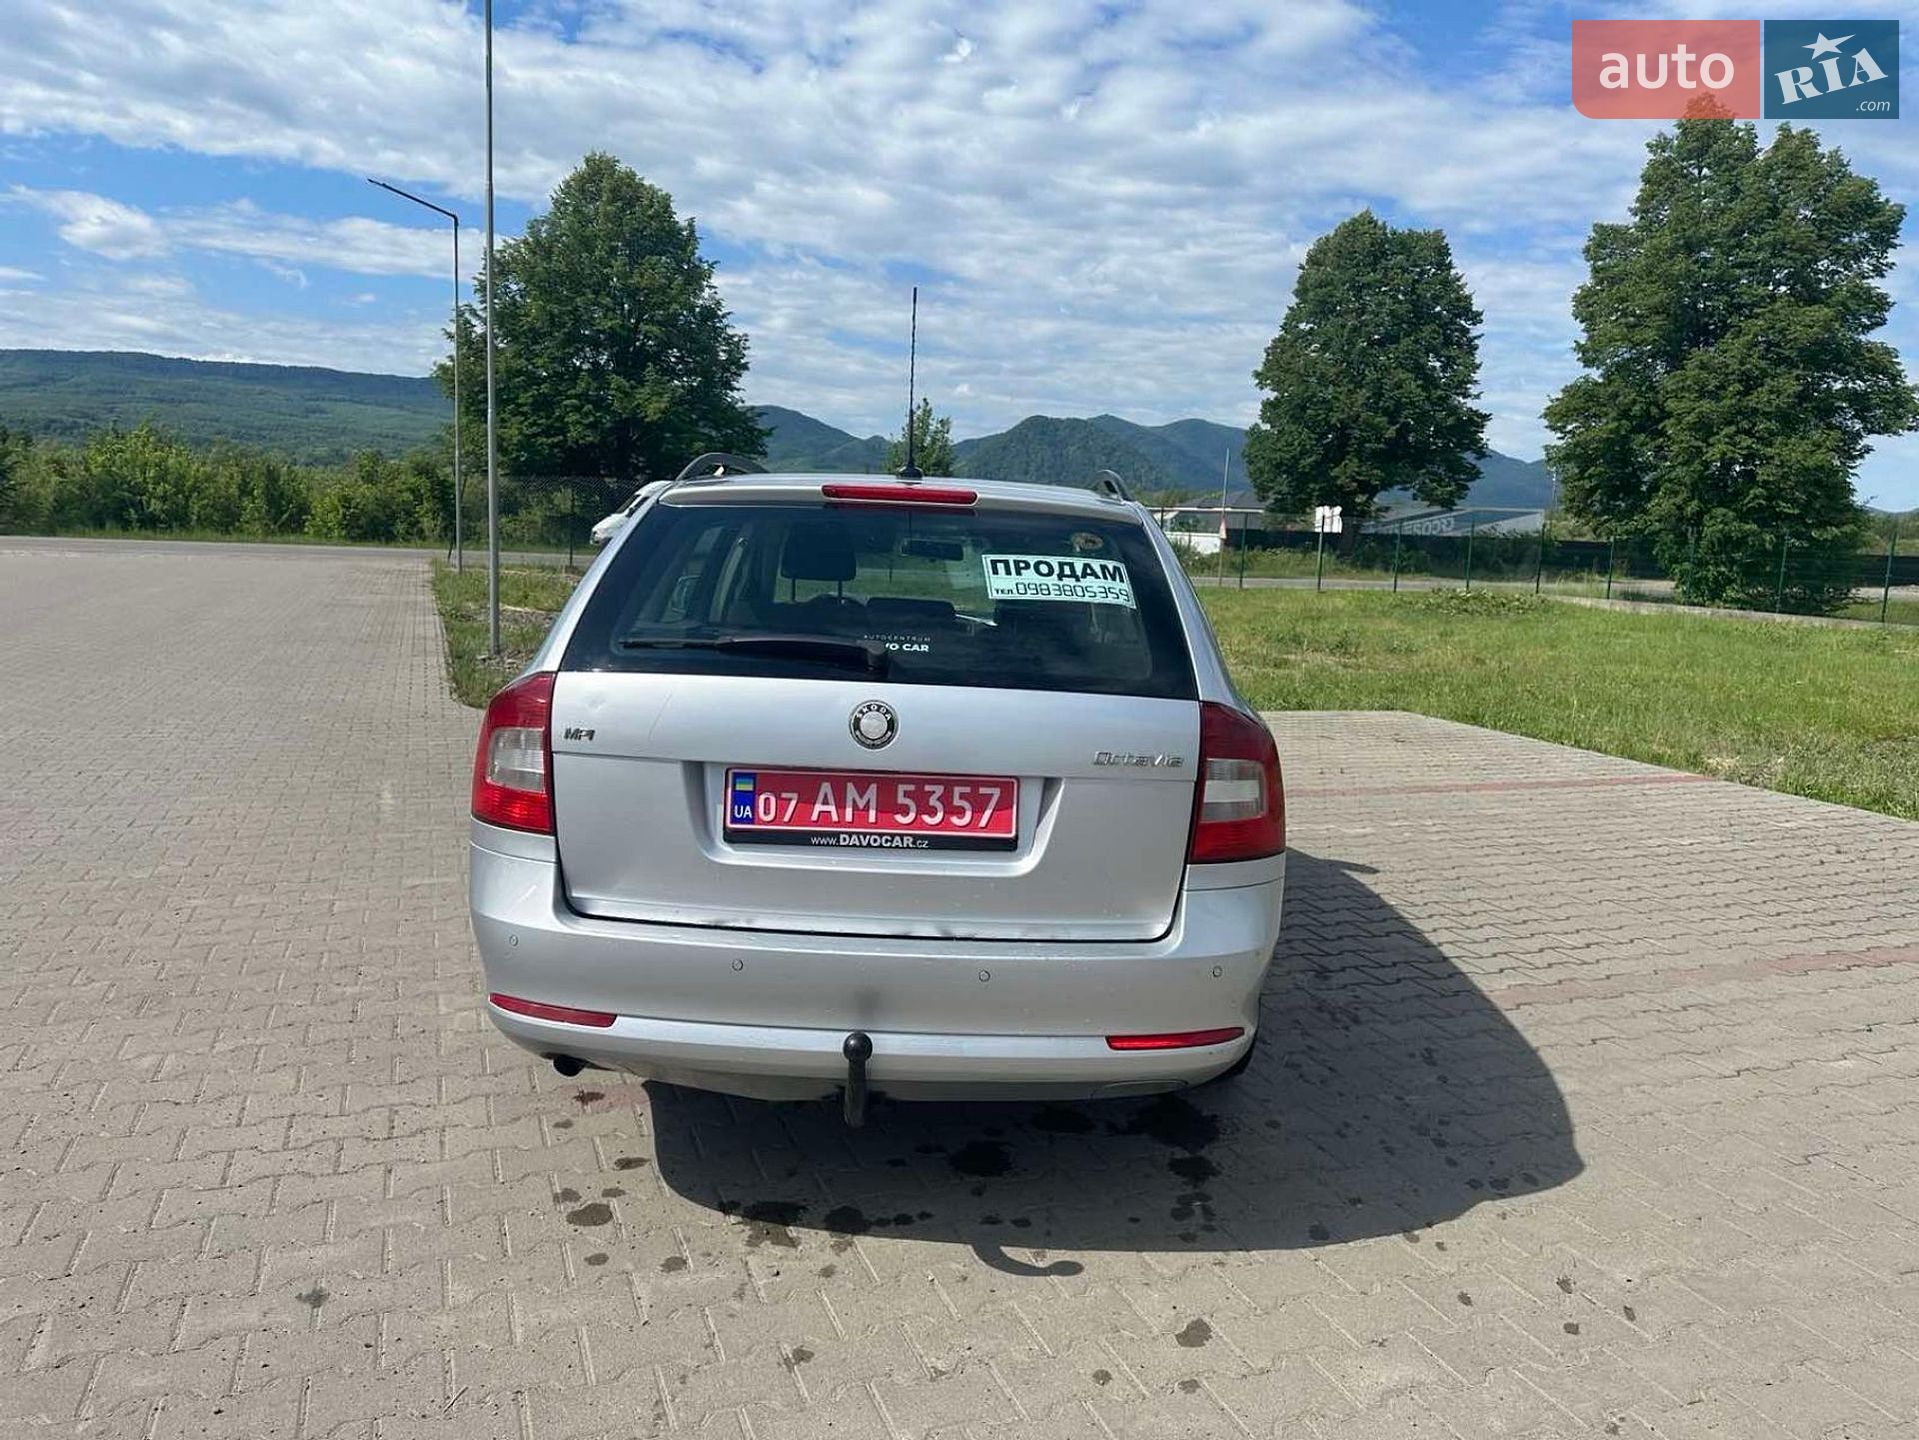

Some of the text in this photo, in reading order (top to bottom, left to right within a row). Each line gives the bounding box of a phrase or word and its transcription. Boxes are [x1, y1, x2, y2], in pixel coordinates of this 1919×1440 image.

[990, 559, 1125, 583] ПРОДАМ
[902, 643, 929, 652] CAR
[734, 805, 753, 818] UA
[758, 782, 1001, 828] 07 AM 5357
[810, 834, 929, 849] www.DAVOCAR.cz
